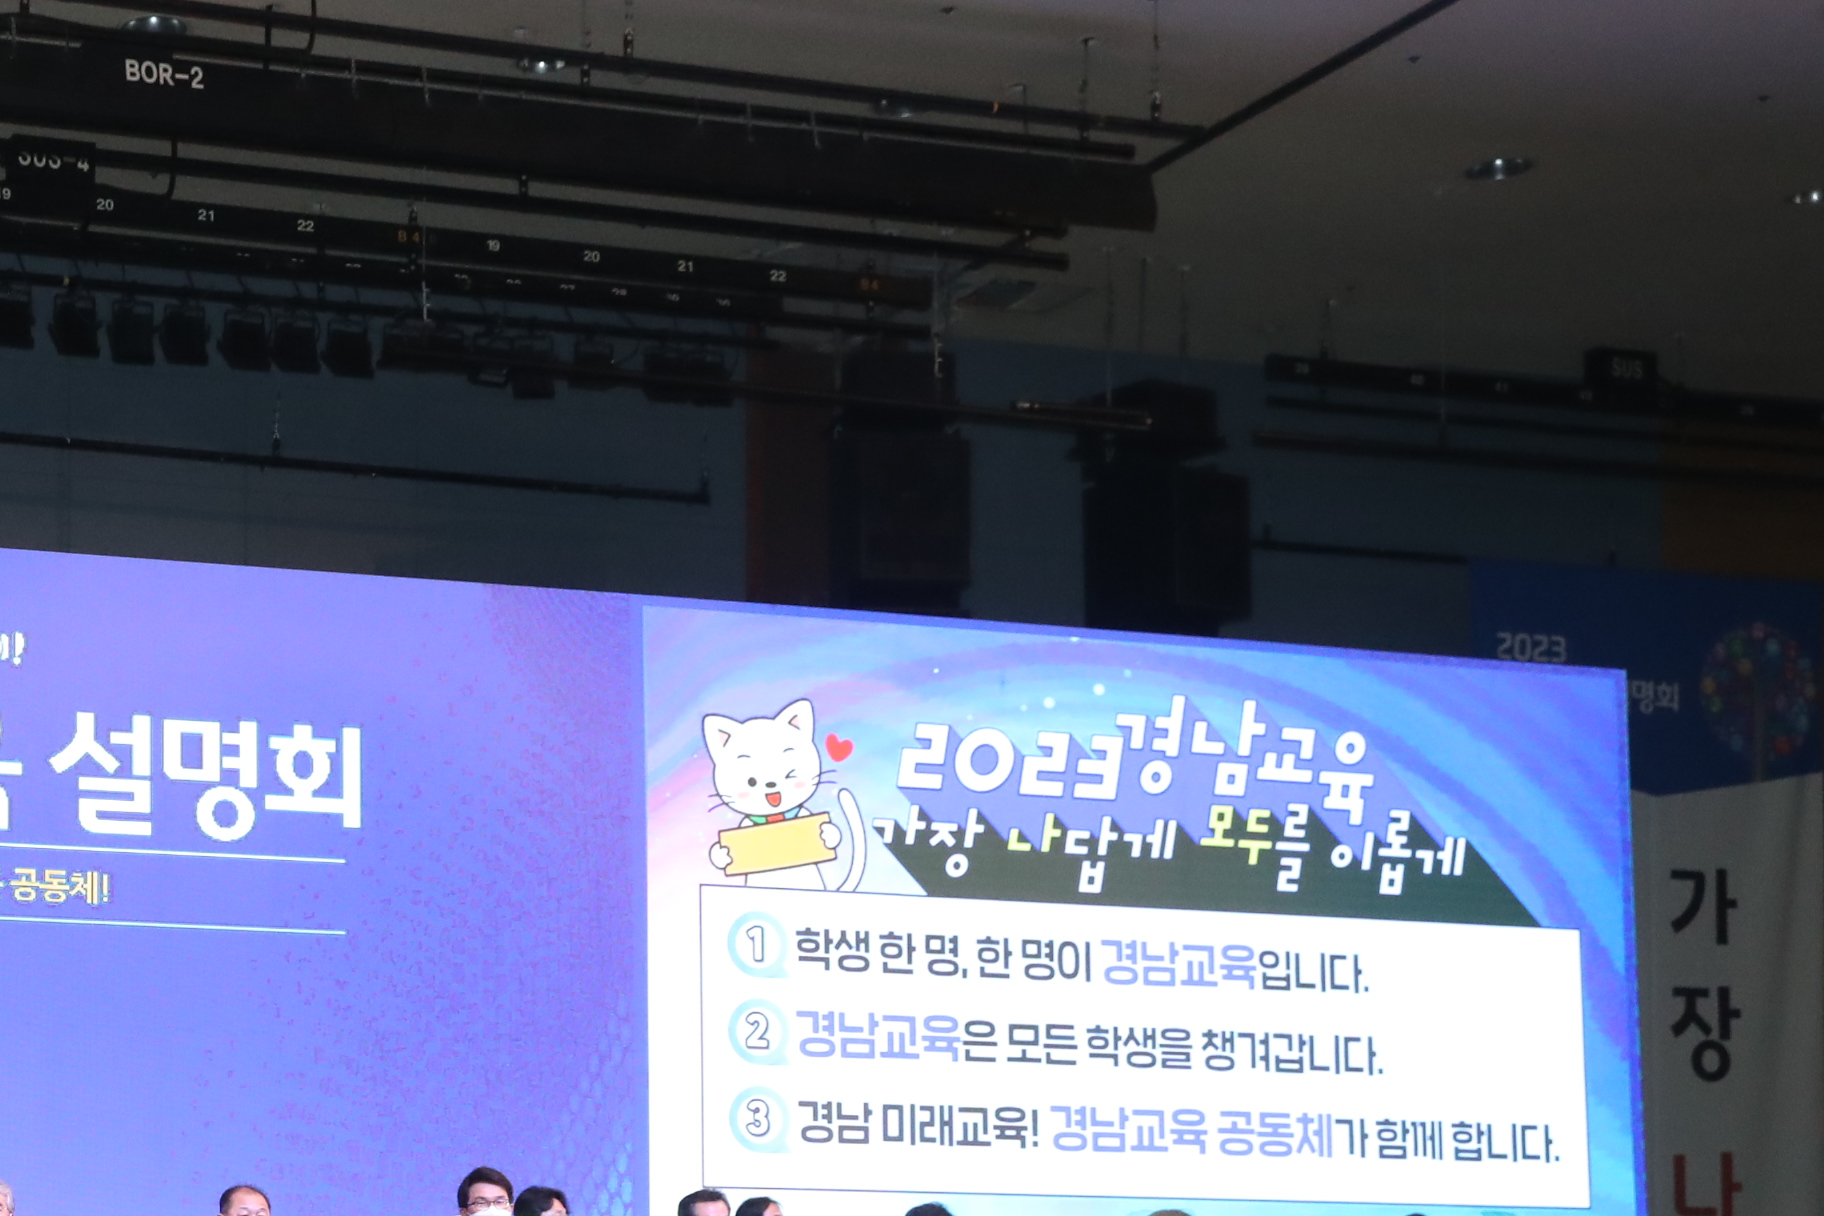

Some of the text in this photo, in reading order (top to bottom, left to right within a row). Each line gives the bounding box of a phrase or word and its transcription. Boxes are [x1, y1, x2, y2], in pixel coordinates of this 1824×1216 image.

[124, 58, 205, 90] BOR-2
[96, 198, 115, 212] 20
[198, 208, 216, 223] 21
[296, 219, 315, 233] 22
[486, 238, 501, 253] 19
[583, 249, 601, 264] 20
[677, 259, 695, 274] 21
[769, 269, 788, 284] 22
[49, 711, 362, 842] 설명회
[873, 803, 1466, 895] 가장 나답게 모두를 이롭게
[11, 867, 111, 906] 공동체!
[746, 925, 1369, 993] 1 학생 한 명, 한 명이 경남교육입니다.
[1670, 868, 1742, 1082] 가장
[744, 1010, 1384, 1076] 2 경남교육은 모든 학생을 챙겨갑니다.
[745, 1098, 1561, 1164] 3 경남 미래교육! 경남교육 공동체가 함께 합니다.
